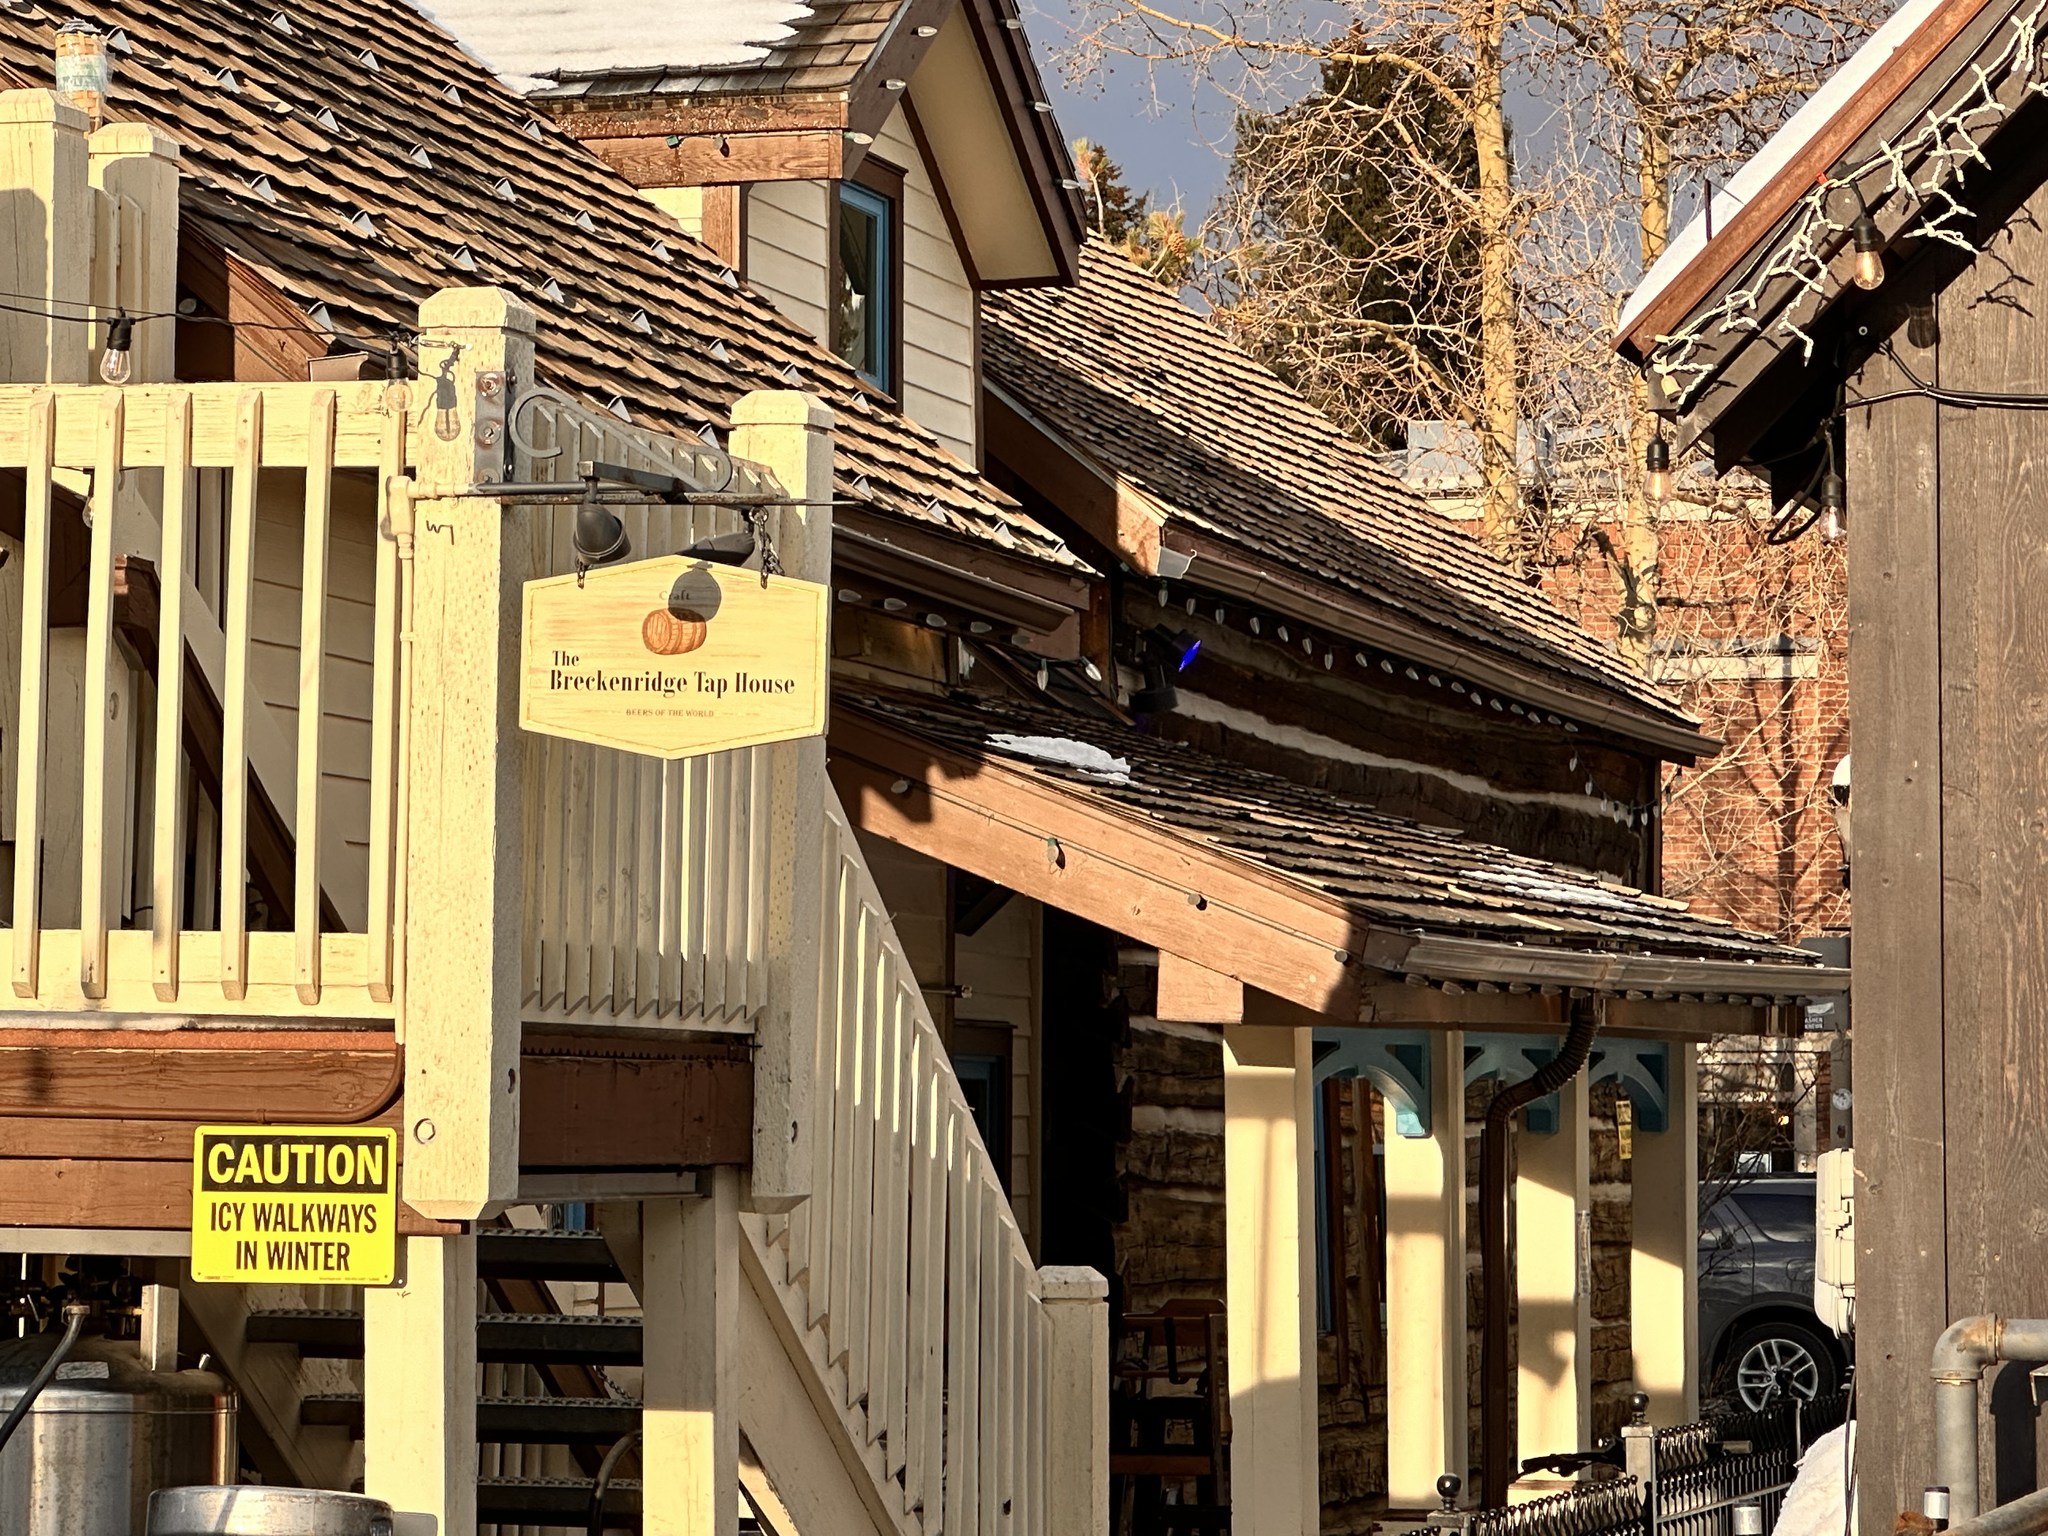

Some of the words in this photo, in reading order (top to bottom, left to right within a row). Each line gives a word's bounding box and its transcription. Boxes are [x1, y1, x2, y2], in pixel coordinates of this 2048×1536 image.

[552, 650, 580, 667] The
[550, 669, 688, 699] Breckenridge
[693, 671, 728, 699] Tap
[735, 672, 796, 695] House
[625, 708, 654, 717] BEERS
[655, 708, 666, 717] OF
[667, 709, 684, 718] THE
[685, 709, 715, 718] WORLD
[208, 1143, 384, 1185] CAUTION
[210, 1202, 246, 1232] ICY
[252, 1202, 377, 1234] WALKWAYS
[236, 1240, 258, 1271] IN
[266, 1241, 351, 1272] WINTER
